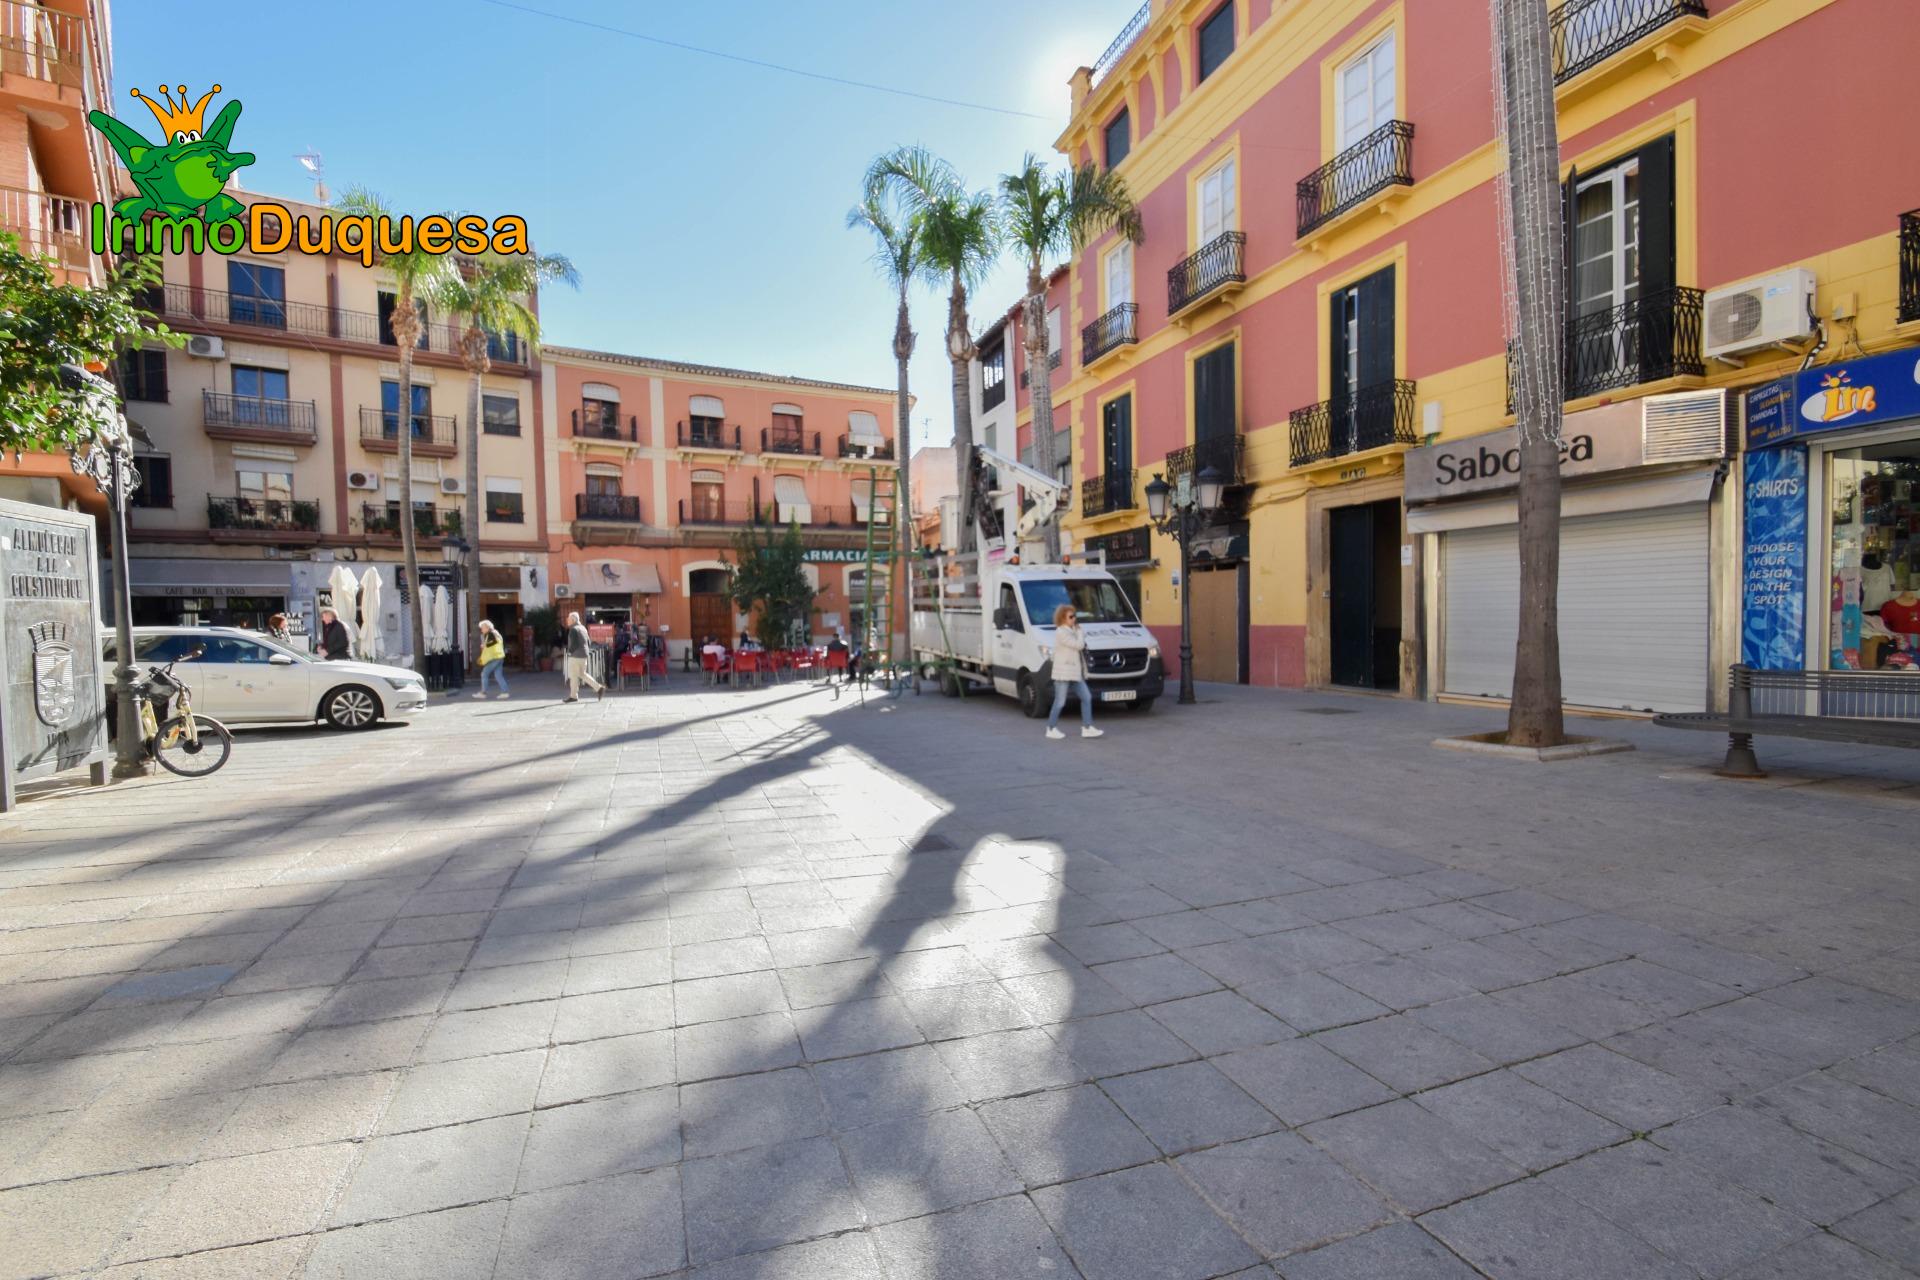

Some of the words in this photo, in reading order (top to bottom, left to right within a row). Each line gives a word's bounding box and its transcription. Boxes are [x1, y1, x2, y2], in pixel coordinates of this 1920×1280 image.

[1436, 434, 1594, 485] Saboa
[1748, 542, 1796, 554] CHOOSE
[800, 549, 869, 561] ARMACI
[1753, 556, 1787, 566] YOUR
[1749, 569, 1793, 580] DESIGN
[1749, 583, 1764, 593] ON
[1766, 581, 1793, 592] THE
[1754, 595, 1785, 605] SPOT
